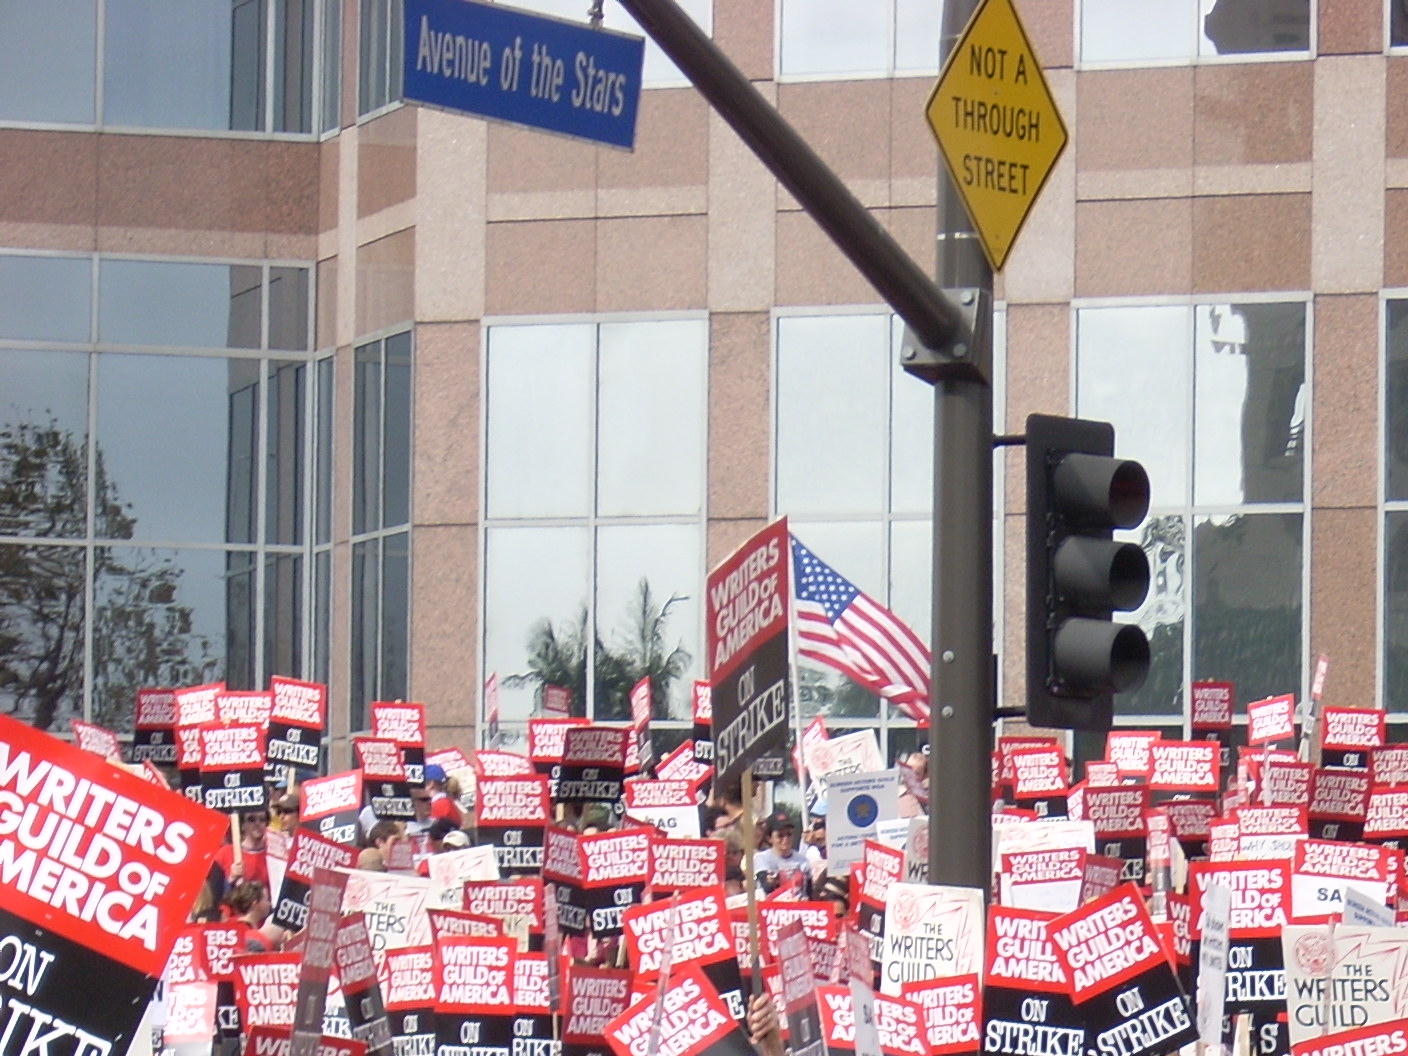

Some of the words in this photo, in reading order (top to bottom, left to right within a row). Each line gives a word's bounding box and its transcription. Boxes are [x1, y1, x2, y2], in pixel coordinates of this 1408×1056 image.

[416, 15, 491, 85] Avenue
[501, 37, 522, 91] of
[530, 43, 564, 102] the
[572, 51, 626, 116] Stars
[970, 45, 1007, 81] NOT
[1015, 54, 1027, 84] A
[952, 97, 1040, 143] THROUGH
[963, 154, 1030, 195] STREET
[712, 537, 780, 612] WRITERS
[716, 581, 760, 639] GUILD
[760, 573, 778, 601] OF
[715, 593, 783, 671] AMERICA
[274, 683, 320, 698] WRITERS
[737, 665, 756, 706] ON
[218, 697, 271, 710] WRITERS
[1326, 712, 1379, 724] WRITERS
[203, 728, 258, 742] WRITERS
[287, 728, 302, 742] ON
[717, 679, 784, 779] STRIKE
[205, 740, 240, 754] GUILD
[1325, 733, 1380, 745] AMERICA
[204, 751, 261, 766] AMERICA
[268, 740, 318, 765] STRIKE
[1014, 752, 1059, 767] WRITERS
[1153, 747, 1213, 760] WRITERS
[1155, 760, 1196, 771] GUILD
[1017, 778, 1064, 792] AMERICA
[1151, 772, 1215, 785] AMERICA
[1315, 776, 1368, 791] WRITERS
[205, 786, 264, 809] STRIKE
[559, 781, 620, 799] STRIKE
[1087, 791, 1143, 805] WRITERS
[0, 741, 194, 864] WRITERS
[1089, 805, 1127, 818] GUILD
[0, 790, 122, 878] GUILD
[118, 862, 170, 901] OF
[504, 831, 522, 845] ON
[583, 836, 648, 855] WRITERS
[298, 835, 352, 864] WRITERS
[653, 844, 717, 859] WRITERS
[1009, 851, 1079, 864] WRITERS
[1304, 842, 1379, 859] WRITERS
[588, 853, 633, 868] GUILD
[655, 859, 700, 872] GUILD
[651, 873, 718, 886] AMERICA
[1196, 869, 1283, 889] WRITERS
[1300, 863, 1380, 879] AMERICA
[0, 839, 159, 951] MERICA
[468, 887, 536, 900] WRITERS
[614, 888, 633, 905] ON
[1261, 893, 1281, 907] OF
[1317, 888, 1342, 902] SA
[375, 902, 396, 912] THE
[368, 913, 406, 933] TERS
[432, 915, 498, 937] WRITERS
[923, 923, 943, 933] THE
[1053, 896, 1137, 951] WRITERS
[890, 935, 954, 961] WRITERS
[1067, 927, 1126, 969] GUILD
[1125, 921, 1144, 938] OF
[389, 953, 432, 971] WRITERS
[442, 946, 509, 966] WRITERS
[1074, 936, 1159, 992] AMERICA
[1229, 947, 1253, 968] ON
[0, 935, 55, 996] ON
[887, 961, 936, 983] GUILD
[1343, 964, 1372, 976] THE
[392, 971, 419, 987] GUILD
[444, 966, 488, 984] GUILD
[247, 985, 293, 1004] GUILD
[388, 984, 435, 1003] AMERICA
[440, 985, 510, 1004] AMERICA
[572, 978, 627, 997] WRITERS
[1225, 969, 1287, 1002] RIKE
[572, 1000, 610, 1015] GUILD
[688, 999, 709, 1018] OF
[1021, 998, 1049, 1022] ON
[1116, 987, 1145, 1017] ON
[403, 1015, 418, 1033] ON
[461, 1021, 481, 1043] ON
[514, 1019, 534, 1036] ON
